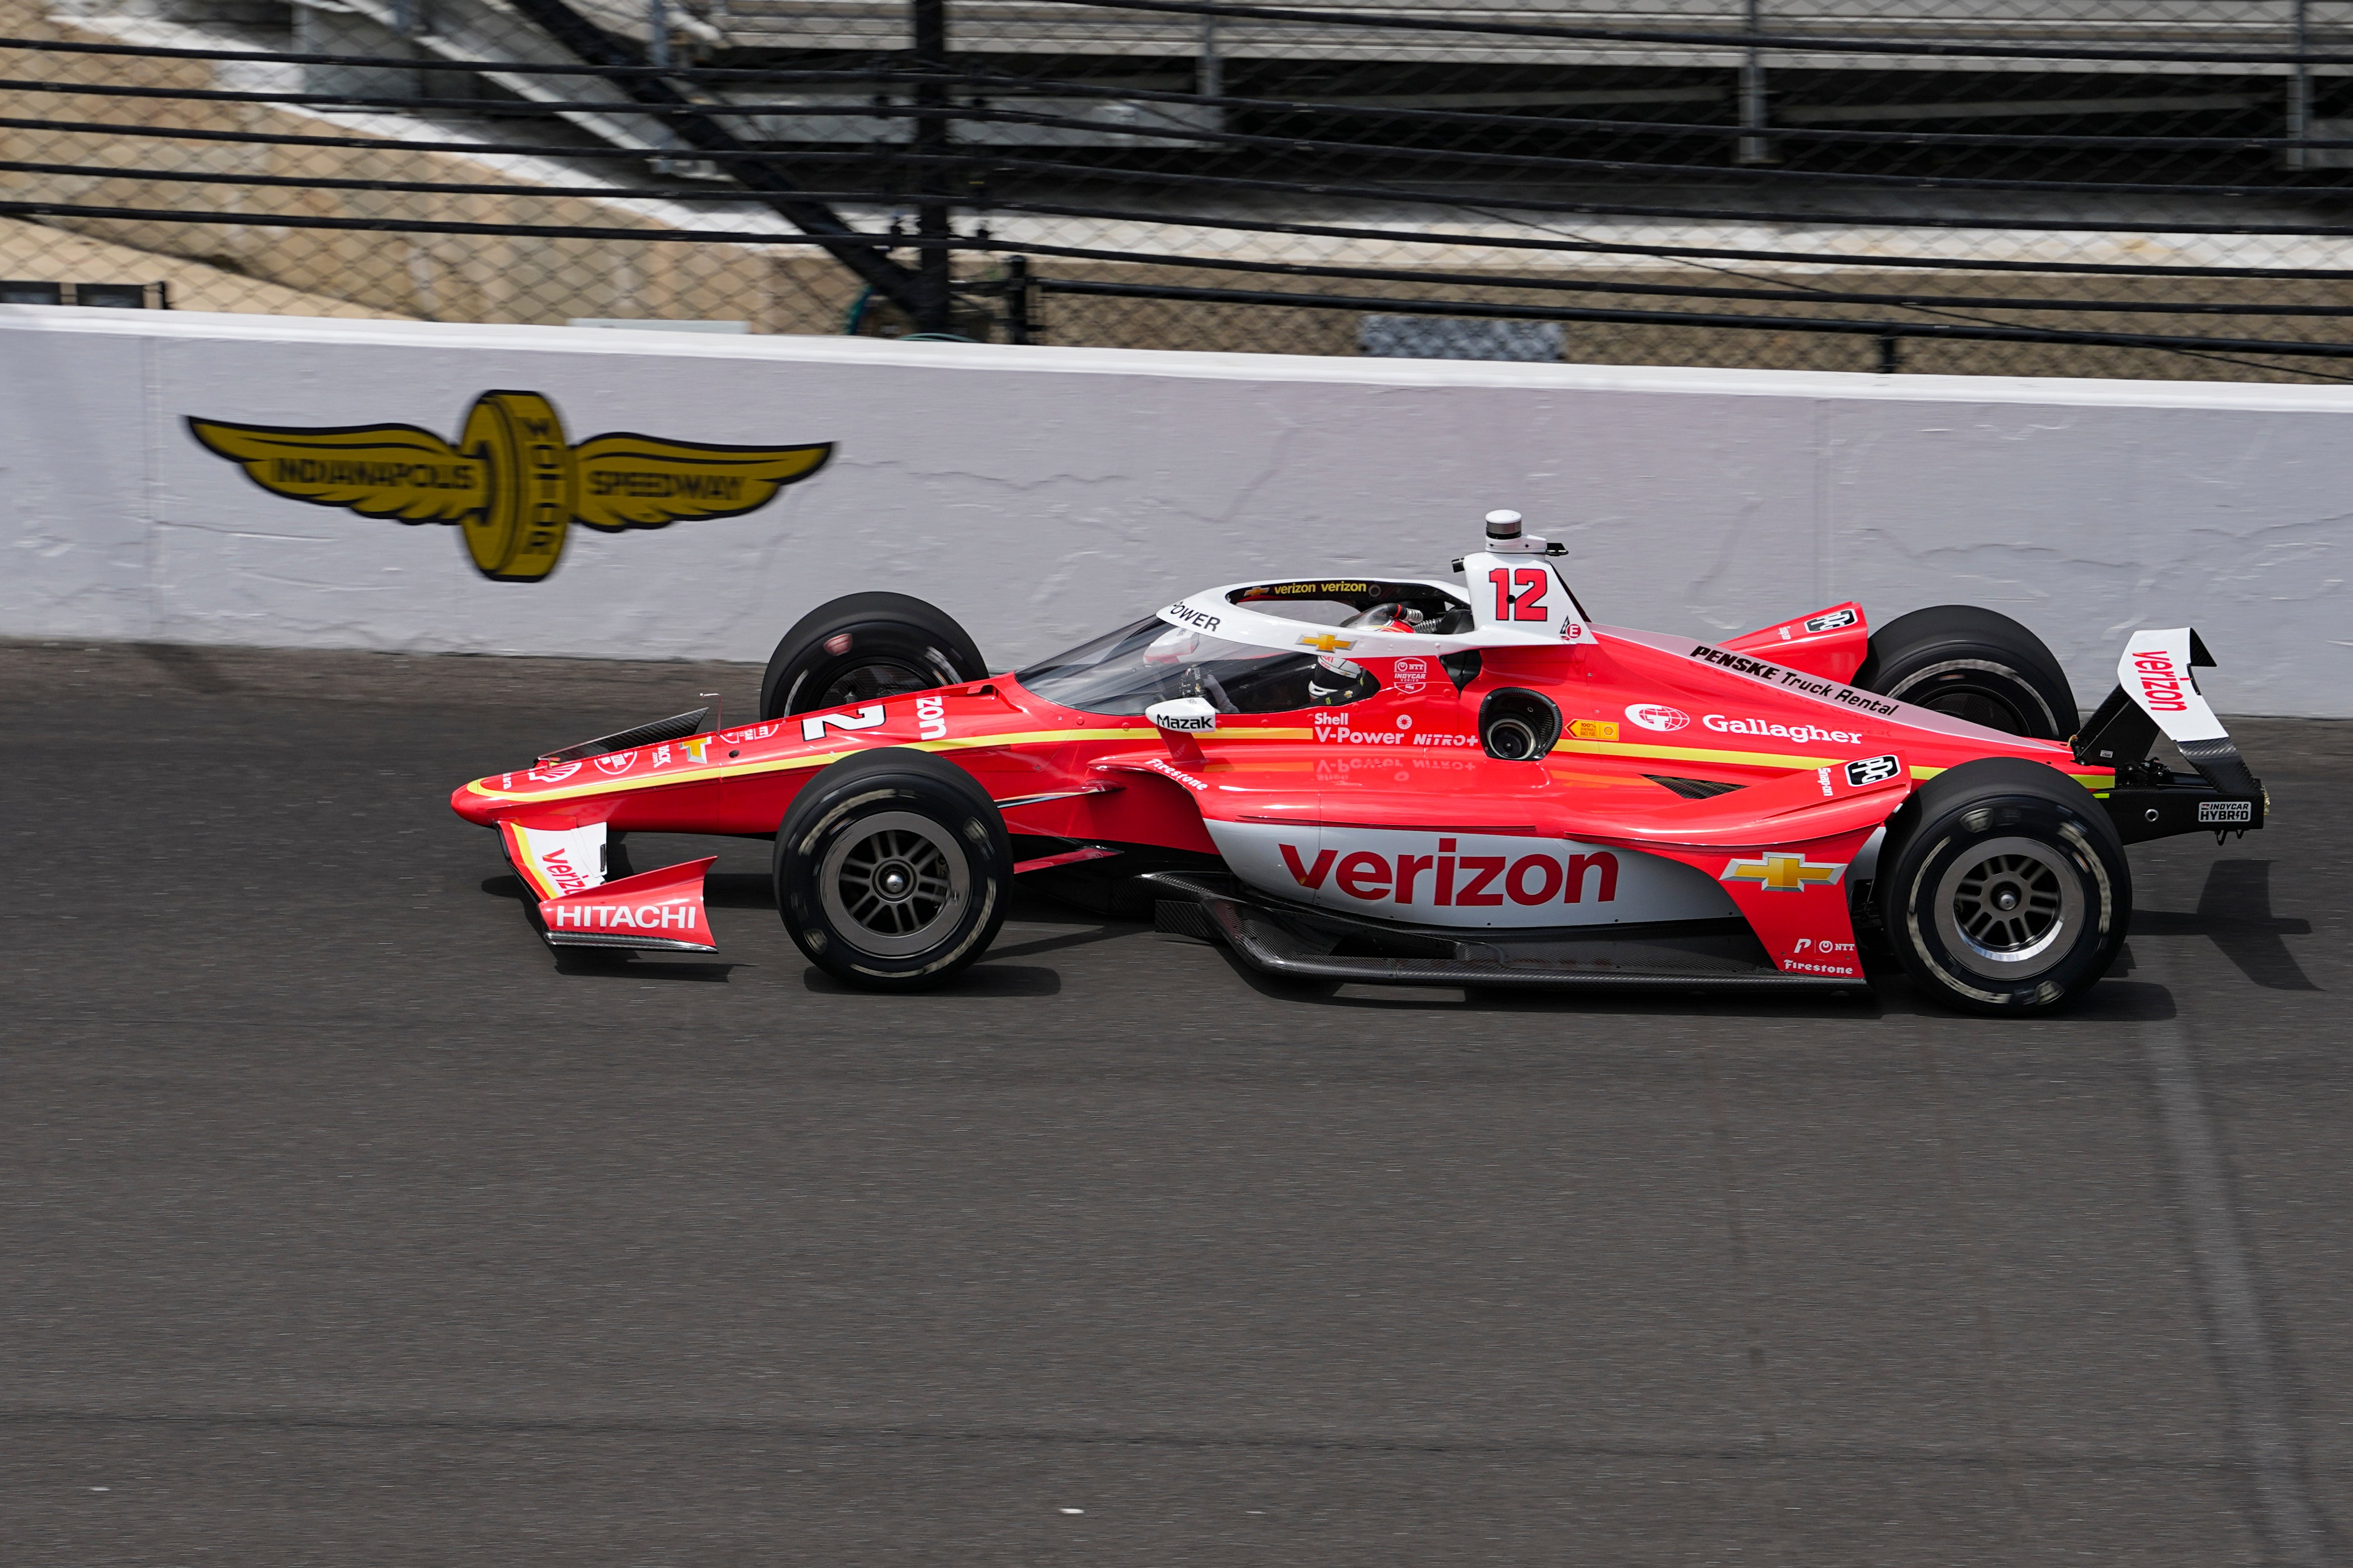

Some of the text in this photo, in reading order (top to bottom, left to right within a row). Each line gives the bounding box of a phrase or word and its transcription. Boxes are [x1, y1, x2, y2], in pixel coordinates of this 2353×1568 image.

[272, 458, 475, 490] INDIANAPOLIS
[588, 470, 744, 501] SPEEDWAY
[1274, 581, 1367, 594] verizon verizon
[1489, 568, 1547, 621] 12
[1690, 645, 1899, 716] PENSKE Truck Rental
[2132, 651, 2190, 711] verizon
[1157, 714, 1214, 729] Mazak
[1314, 712, 1348, 725] Shell
[1702, 714, 1863, 745] Gallagher
[1315, 726, 1405, 744] V-Power
[1145, 758, 1208, 790] Firestone
[1278, 838, 1619, 906] verizon
[557, 905, 696, 929] HITACHI
[1835, 943, 1855, 951] NTT
[1784, 959, 1853, 974] Firestone
